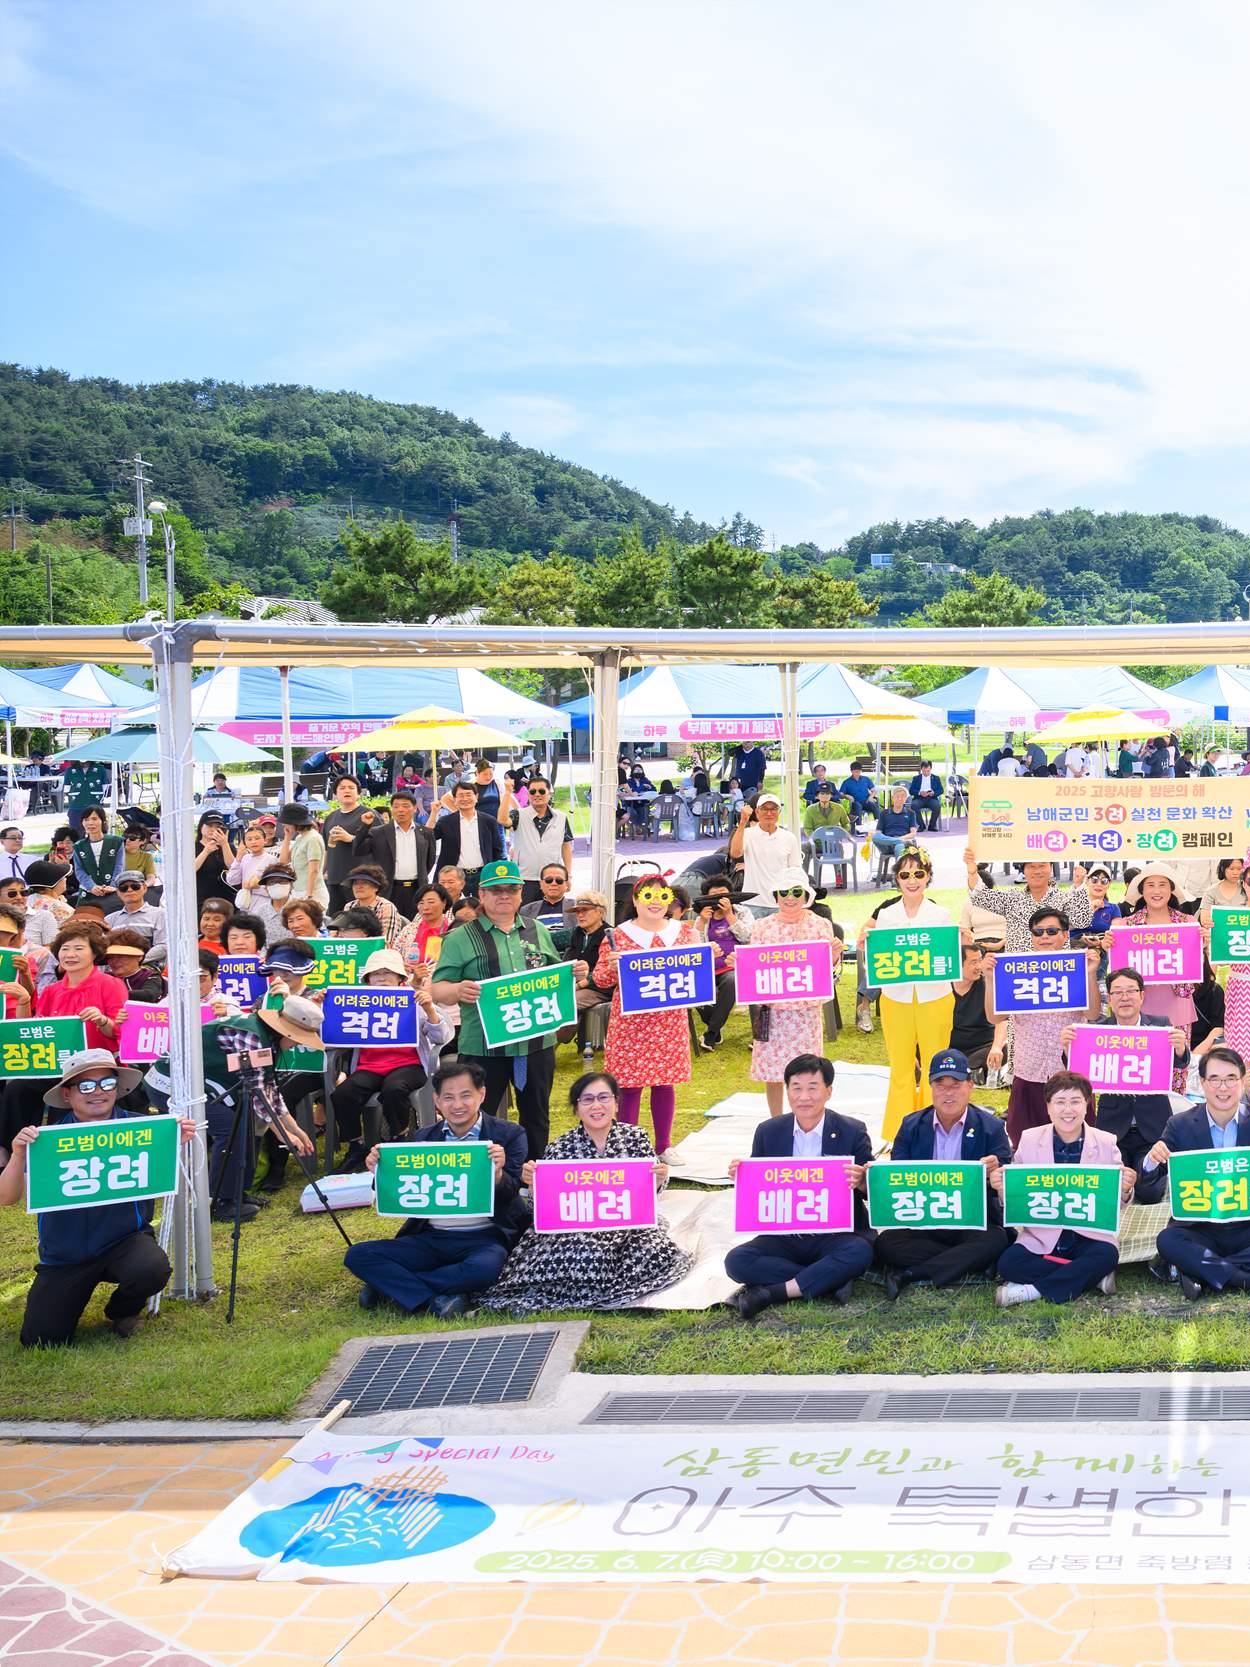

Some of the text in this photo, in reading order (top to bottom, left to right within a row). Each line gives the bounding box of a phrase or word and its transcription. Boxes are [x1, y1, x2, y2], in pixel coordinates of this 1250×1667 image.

[308, 723, 338, 732] 즐거운
[341, 723, 361, 732] 추억
[643, 725, 667, 736] 하루
[714, 721, 749, 734] 꾸미기
[752, 720, 775, 733] 체험
[1055, 784, 1206, 799] 2025 고향사람 방문의 해
[1026, 807, 1089, 821] 남해군민
[1131, 807, 1162, 821] 실천
[1166, 806, 1198, 821] 문화
[1201, 806, 1233, 820] 확산
[1026, 830, 1068, 852] 배려
[1182, 832, 1234, 848] 캠페인
[896, 934, 929, 945] 모범은
[1132, 933, 1178, 944] 이웃에겐
[324, 945, 357, 955] 모범은
[760, 950, 807, 963] 이웃에겐
[303, 959, 366, 984] 장려
[629, 954, 702, 971] 어려운이에겐
[872, 949, 953, 980] 장려를!
[1006, 960, 1074, 972] 어려운이에겐
[1128, 949, 1183, 976] 배려
[496, 974, 559, 999] 모범이에겐
[639, 972, 695, 1001] 격려
[756, 967, 813, 995] 배려
[1014, 976, 1068, 1004] 격려
[334, 996, 408, 1007] 어려운이에겐
[144, 1012, 167, 1022] 이웃
[501, 992, 562, 1034] 장려
[21, 1026, 54, 1038] 모범은
[342, 1012, 399, 1039] 격려
[137, 1026, 169, 1057] 배
[1097, 1036, 1147, 1050] 이웃에겐
[1089, 1054, 1151, 1084] 배려
[57, 1130, 151, 1152] 모범이에겐
[397, 1153, 471, 1168] 모범이에겐
[1206, 1158, 1248, 1173] 모범은
[59, 1152, 149, 1197] 장려
[565, 1170, 624, 1184] 이웃에겐
[765, 1168, 823, 1182] 이웃에겐
[891, 1172, 962, 1186] 모범이에겐
[1026, 1175, 1098, 1188] 모범이에겐
[399, 1174, 467, 1207] 장려
[560, 1189, 631, 1223] 배려
[759, 1189, 828, 1223] 배려
[892, 1191, 961, 1220] 장려
[1028, 1192, 1095, 1221] 장려
[509, 1444, 556, 1463] Day
[662, 1443, 1225, 1477] 삼동면민과 함께하는
[613, 1484, 855, 1536] 아주
[888, 1484, 1246, 1539] 특별한
[501, 1552, 600, 1571] 2025.
[612, 1553, 640, 1571] 6.
[749, 1549, 841, 1571] 10:00
[884, 1552, 974, 1571] 16:00
[1027, 1554, 1123, 1572] 삼동면
[1136, 1554, 1233, 1572] 죽방렴
